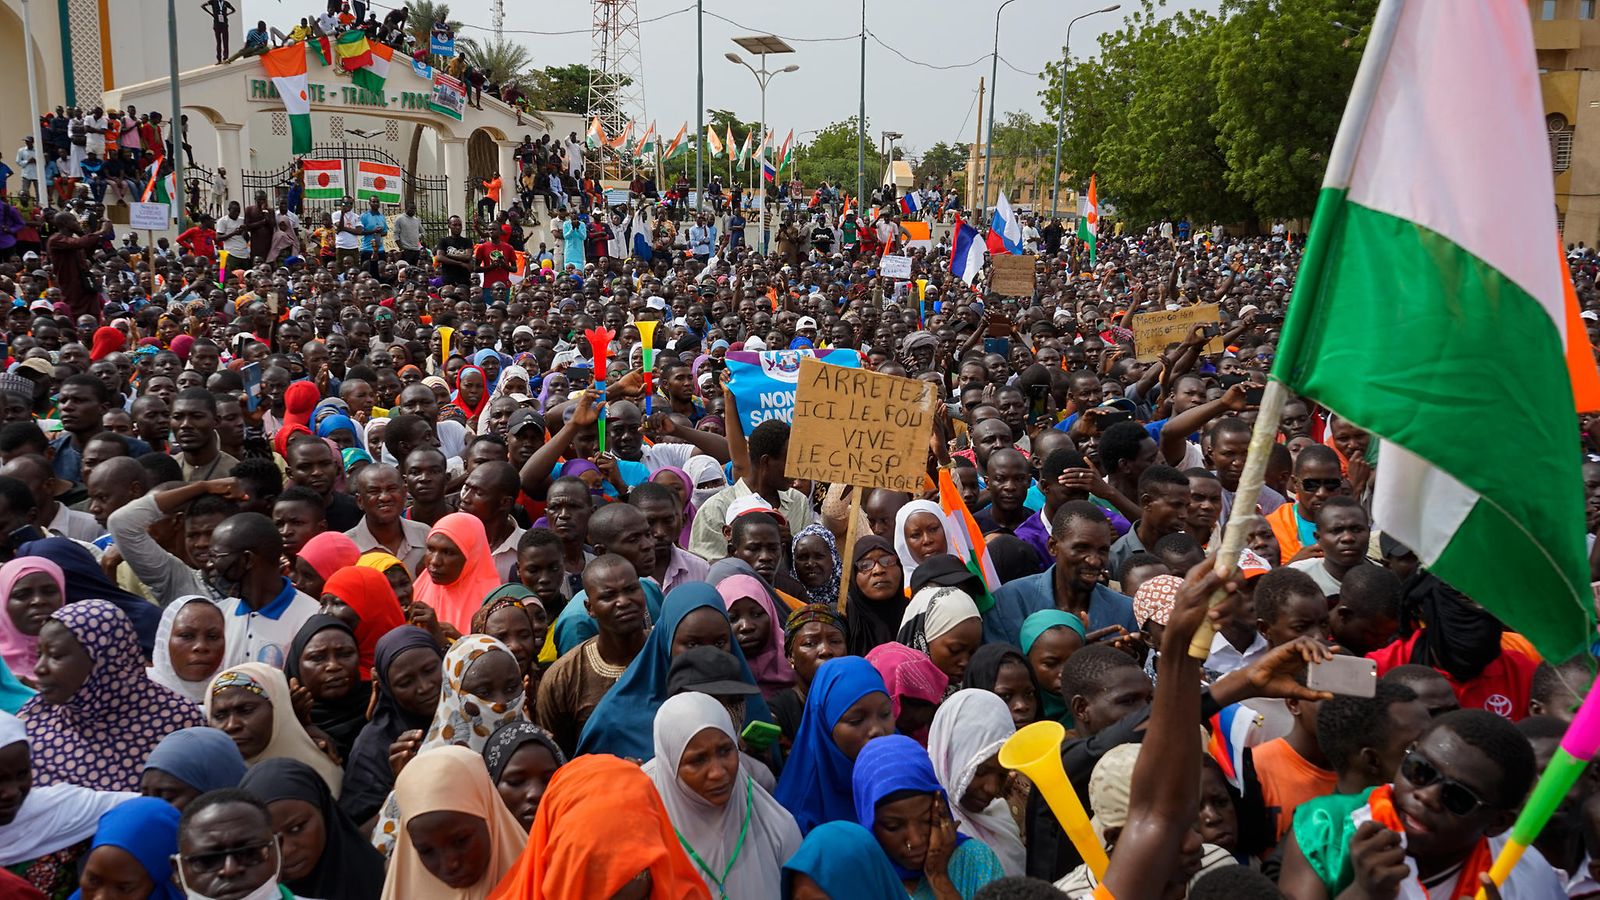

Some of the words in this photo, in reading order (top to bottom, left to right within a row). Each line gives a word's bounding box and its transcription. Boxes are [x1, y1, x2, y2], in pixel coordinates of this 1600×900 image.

[812, 365, 930, 403] ARRETEZ
[760, 390, 797, 409] NON
[842, 427, 896, 451] VIVE
